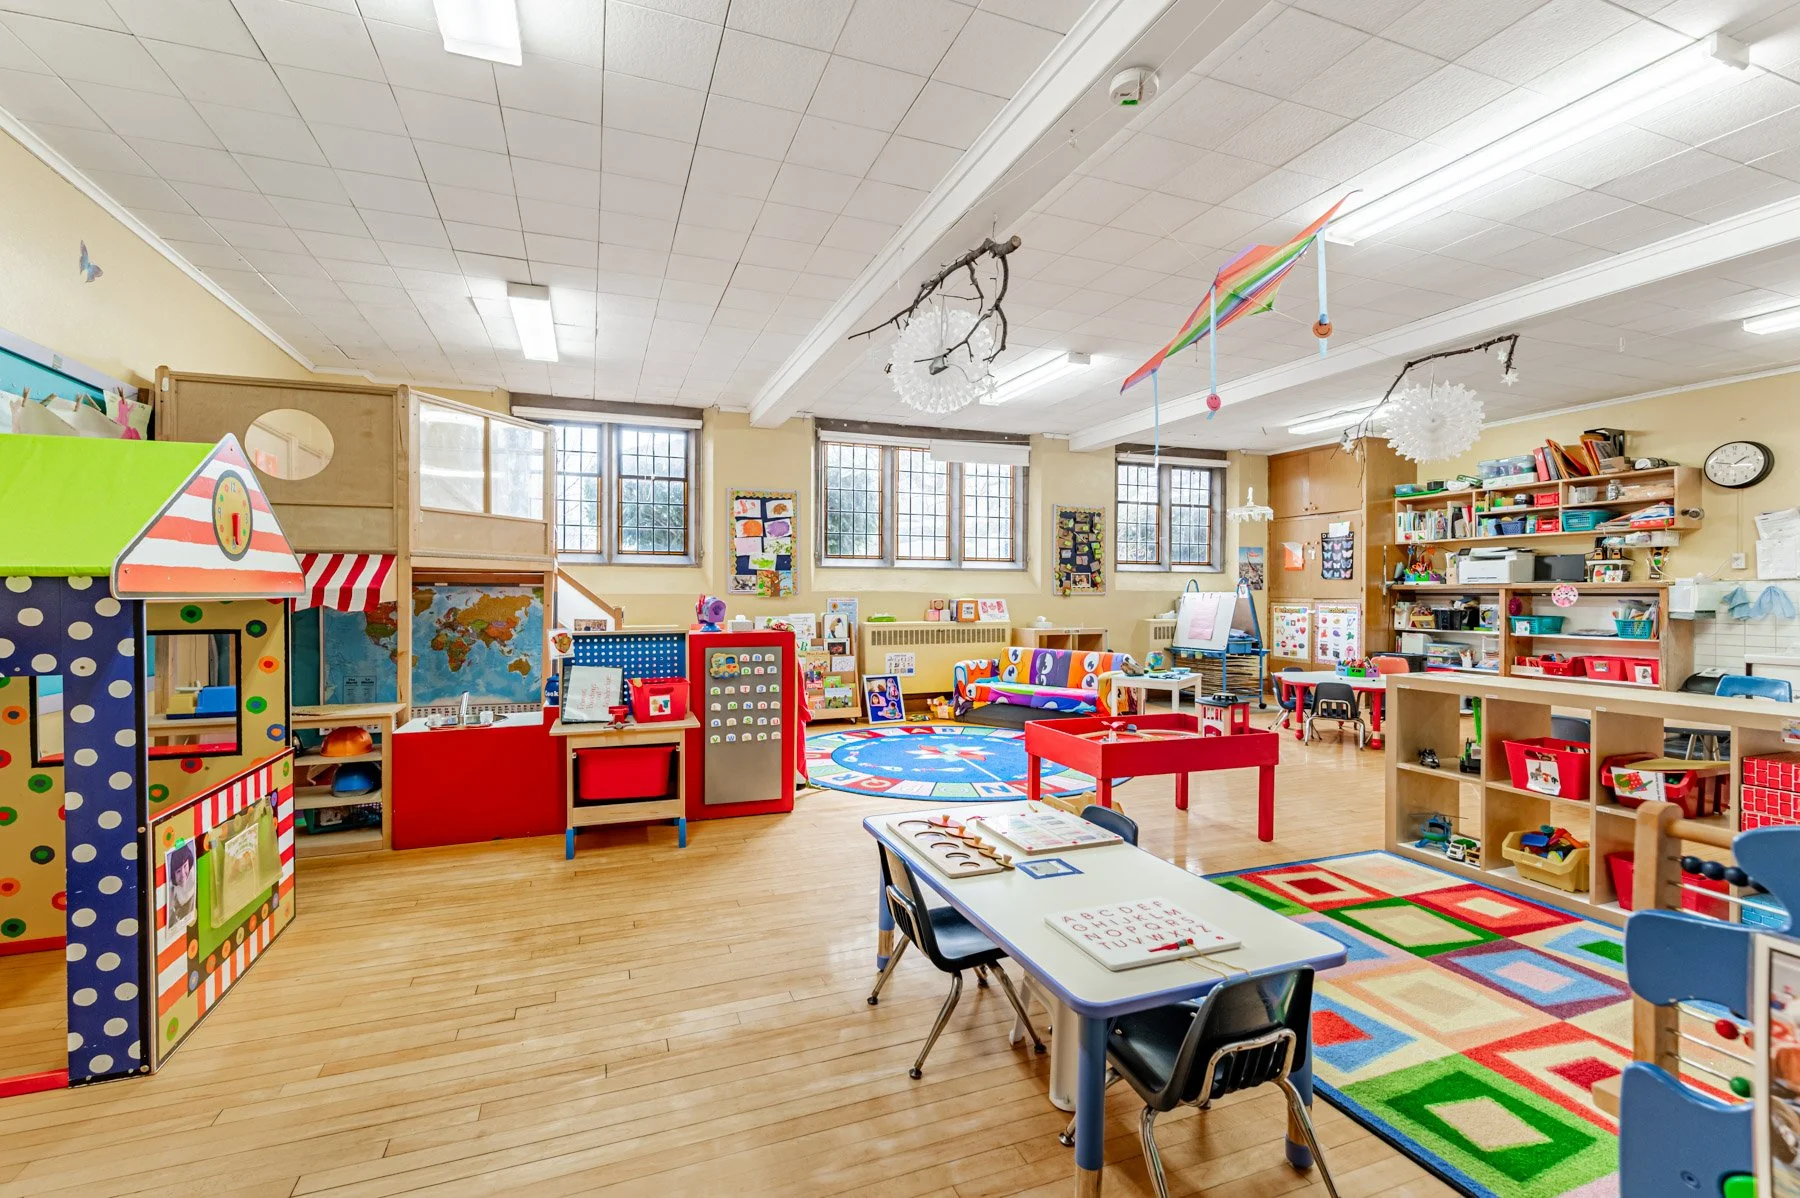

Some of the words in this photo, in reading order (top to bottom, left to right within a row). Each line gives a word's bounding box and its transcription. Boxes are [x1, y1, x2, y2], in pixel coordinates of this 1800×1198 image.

[980, 785, 1012, 794] N
[1084, 933, 1102, 941] N
[1098, 942, 1112, 950] T
[1129, 937, 1143, 945] V
[1147, 933, 1164, 941] W
[1195, 924, 1212, 933] Z
